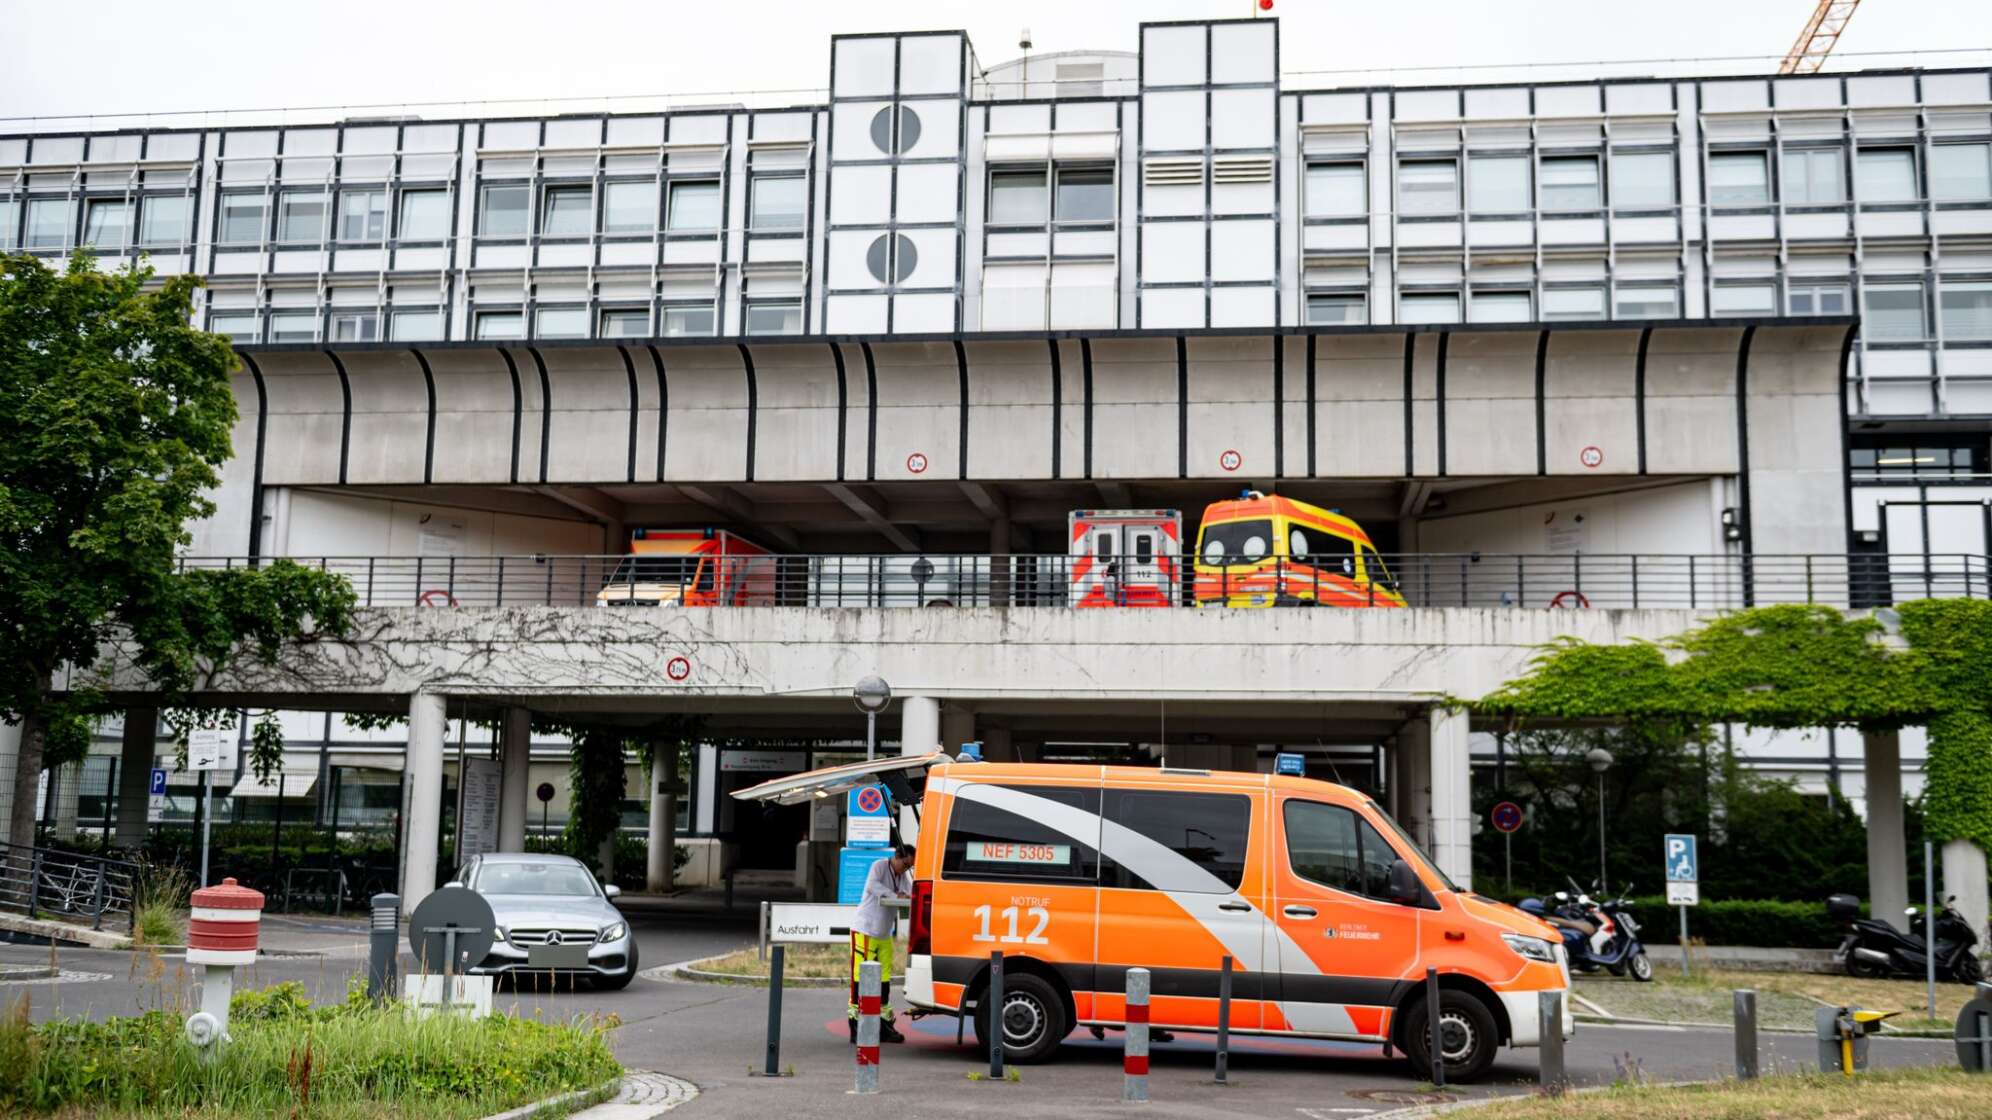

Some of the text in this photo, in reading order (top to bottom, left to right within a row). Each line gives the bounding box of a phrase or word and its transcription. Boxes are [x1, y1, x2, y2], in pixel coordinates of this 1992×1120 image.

[1136, 570, 1152, 578] 112
[153, 772, 163, 792] P
[983, 843, 1054, 861] NEF 5305
[1669, 839, 1686, 858] P
[1011, 896, 1051, 907] NOTRUF
[777, 924, 820, 935] Ausfahrt
[972, 905, 1049, 945] 112
